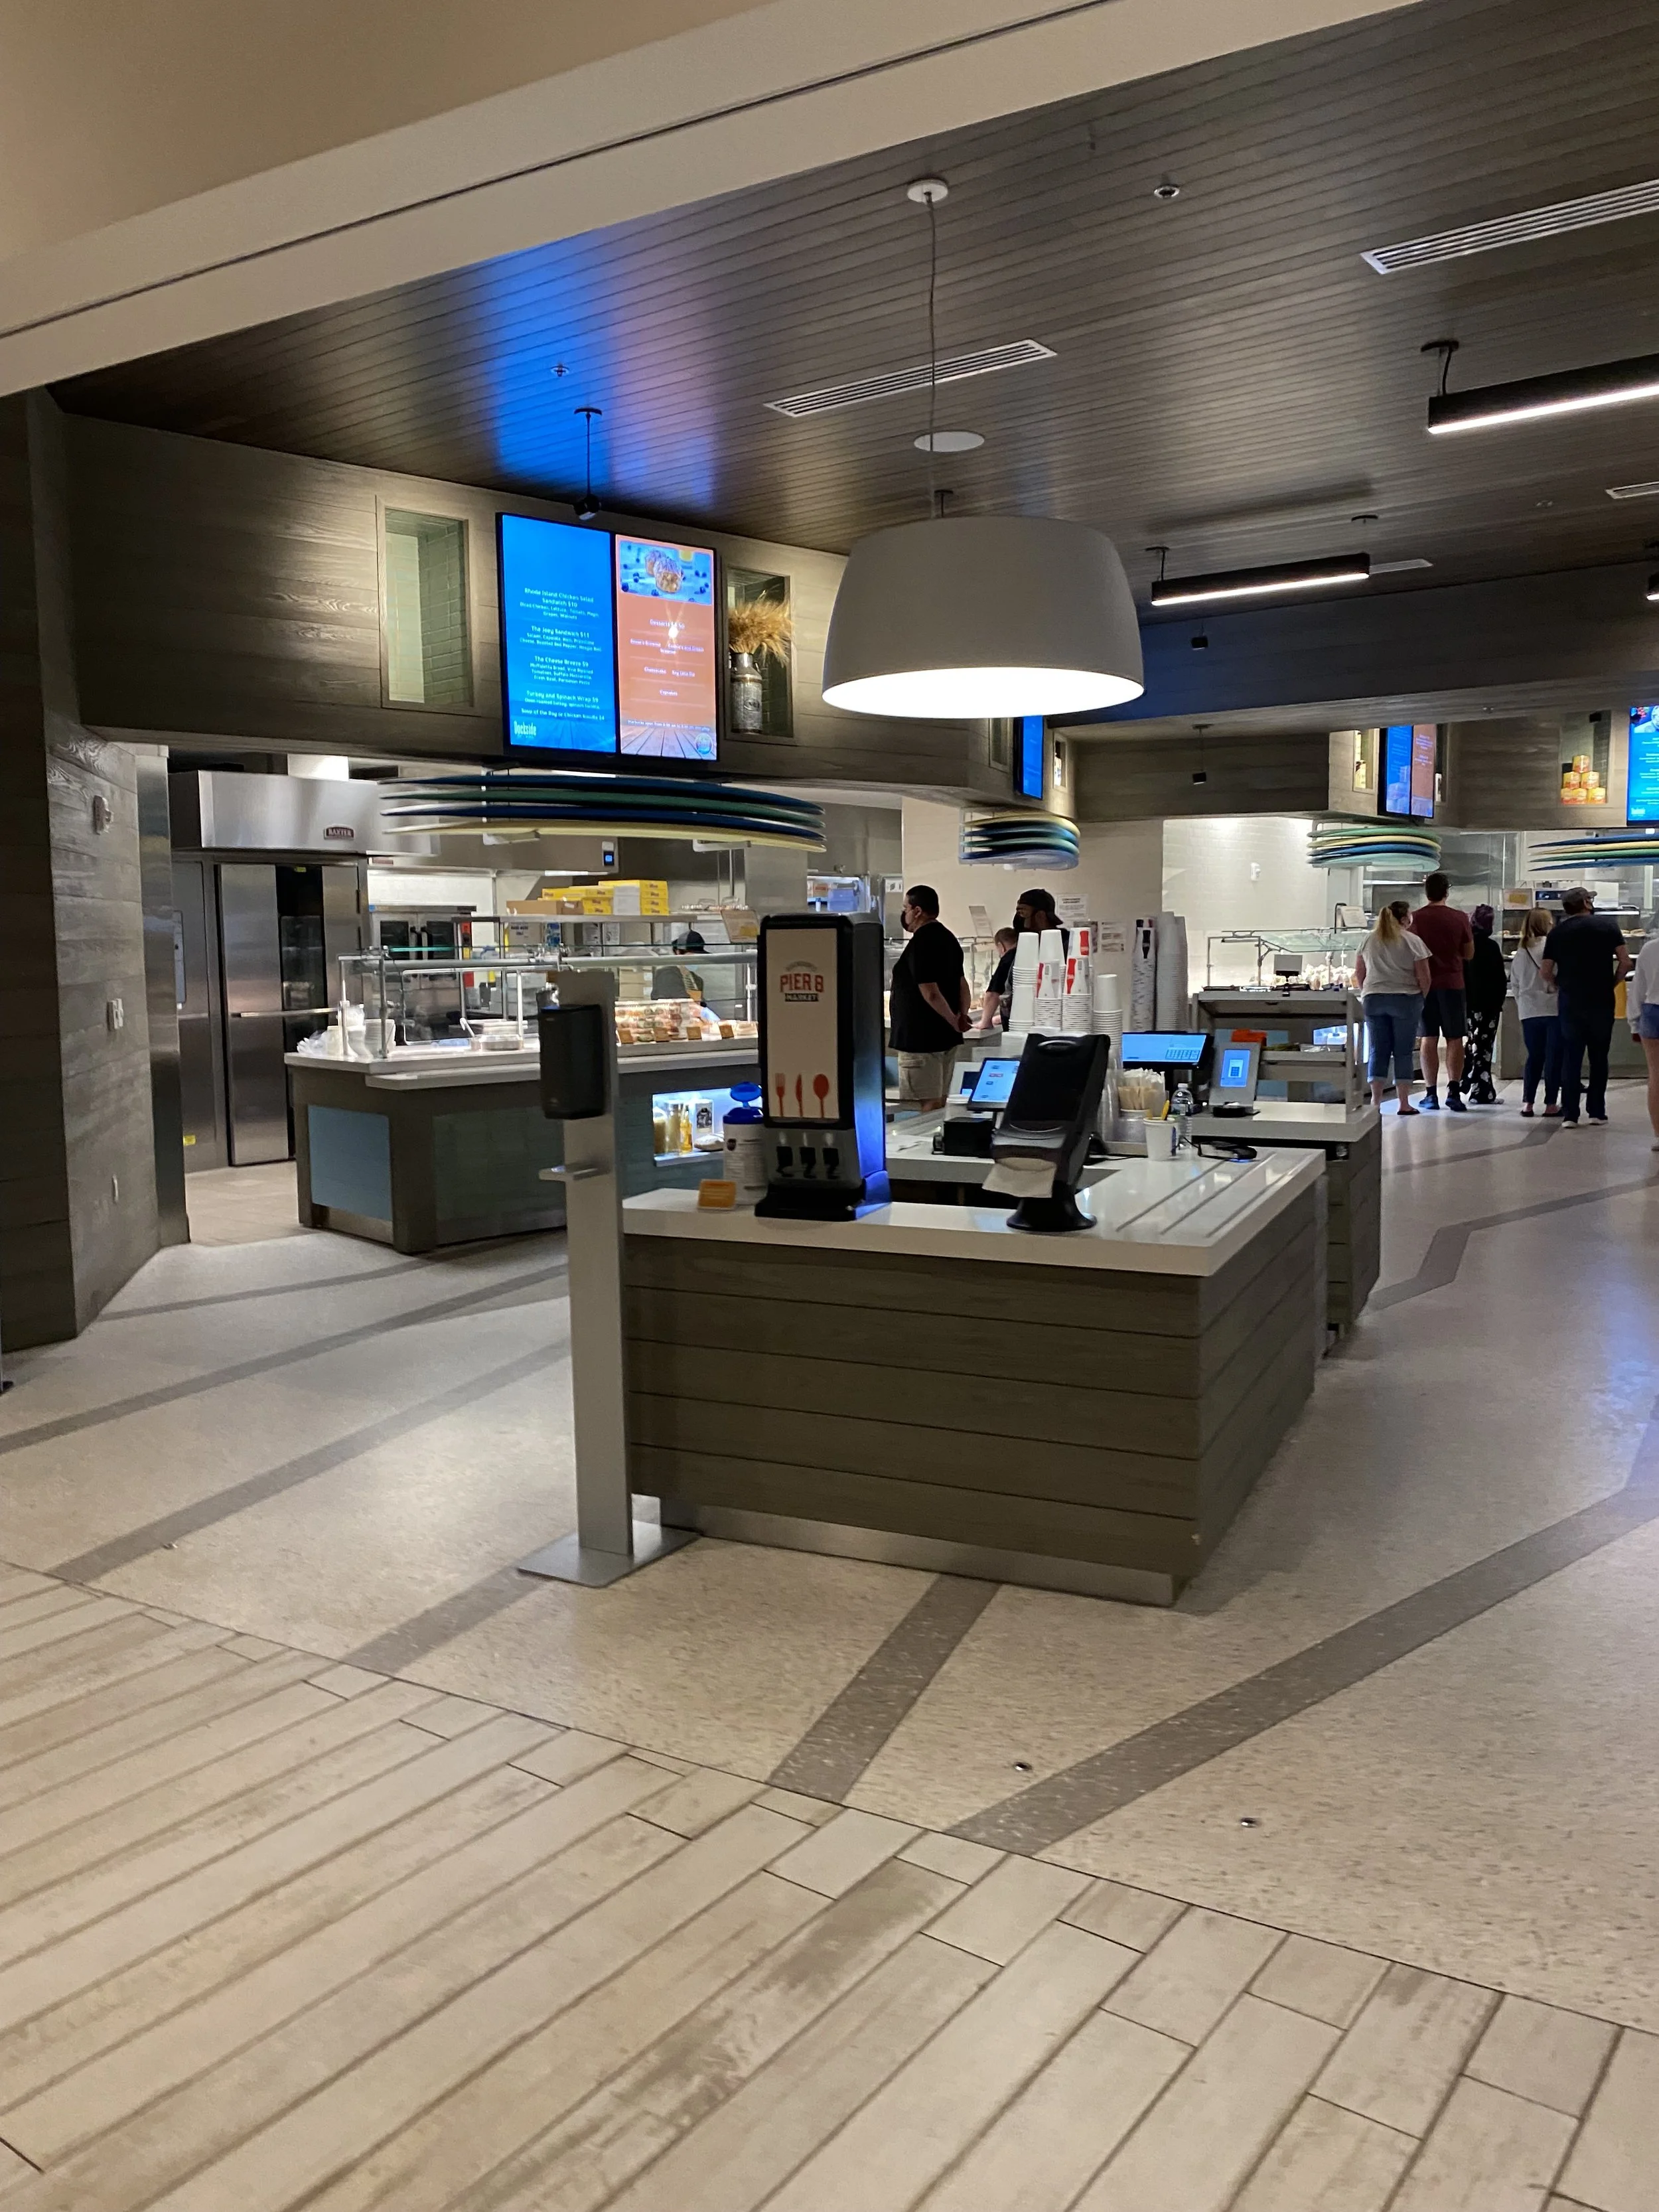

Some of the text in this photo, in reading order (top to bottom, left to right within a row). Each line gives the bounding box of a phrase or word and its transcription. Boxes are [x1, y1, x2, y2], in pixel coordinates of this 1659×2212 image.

[542, 597, 567, 606] Sandwich
[555, 628, 579, 637] Sandwich
[526, 690, 545, 699] Turkey
[514, 720, 537, 736] Dockside
[780, 973, 812, 993] PIER
